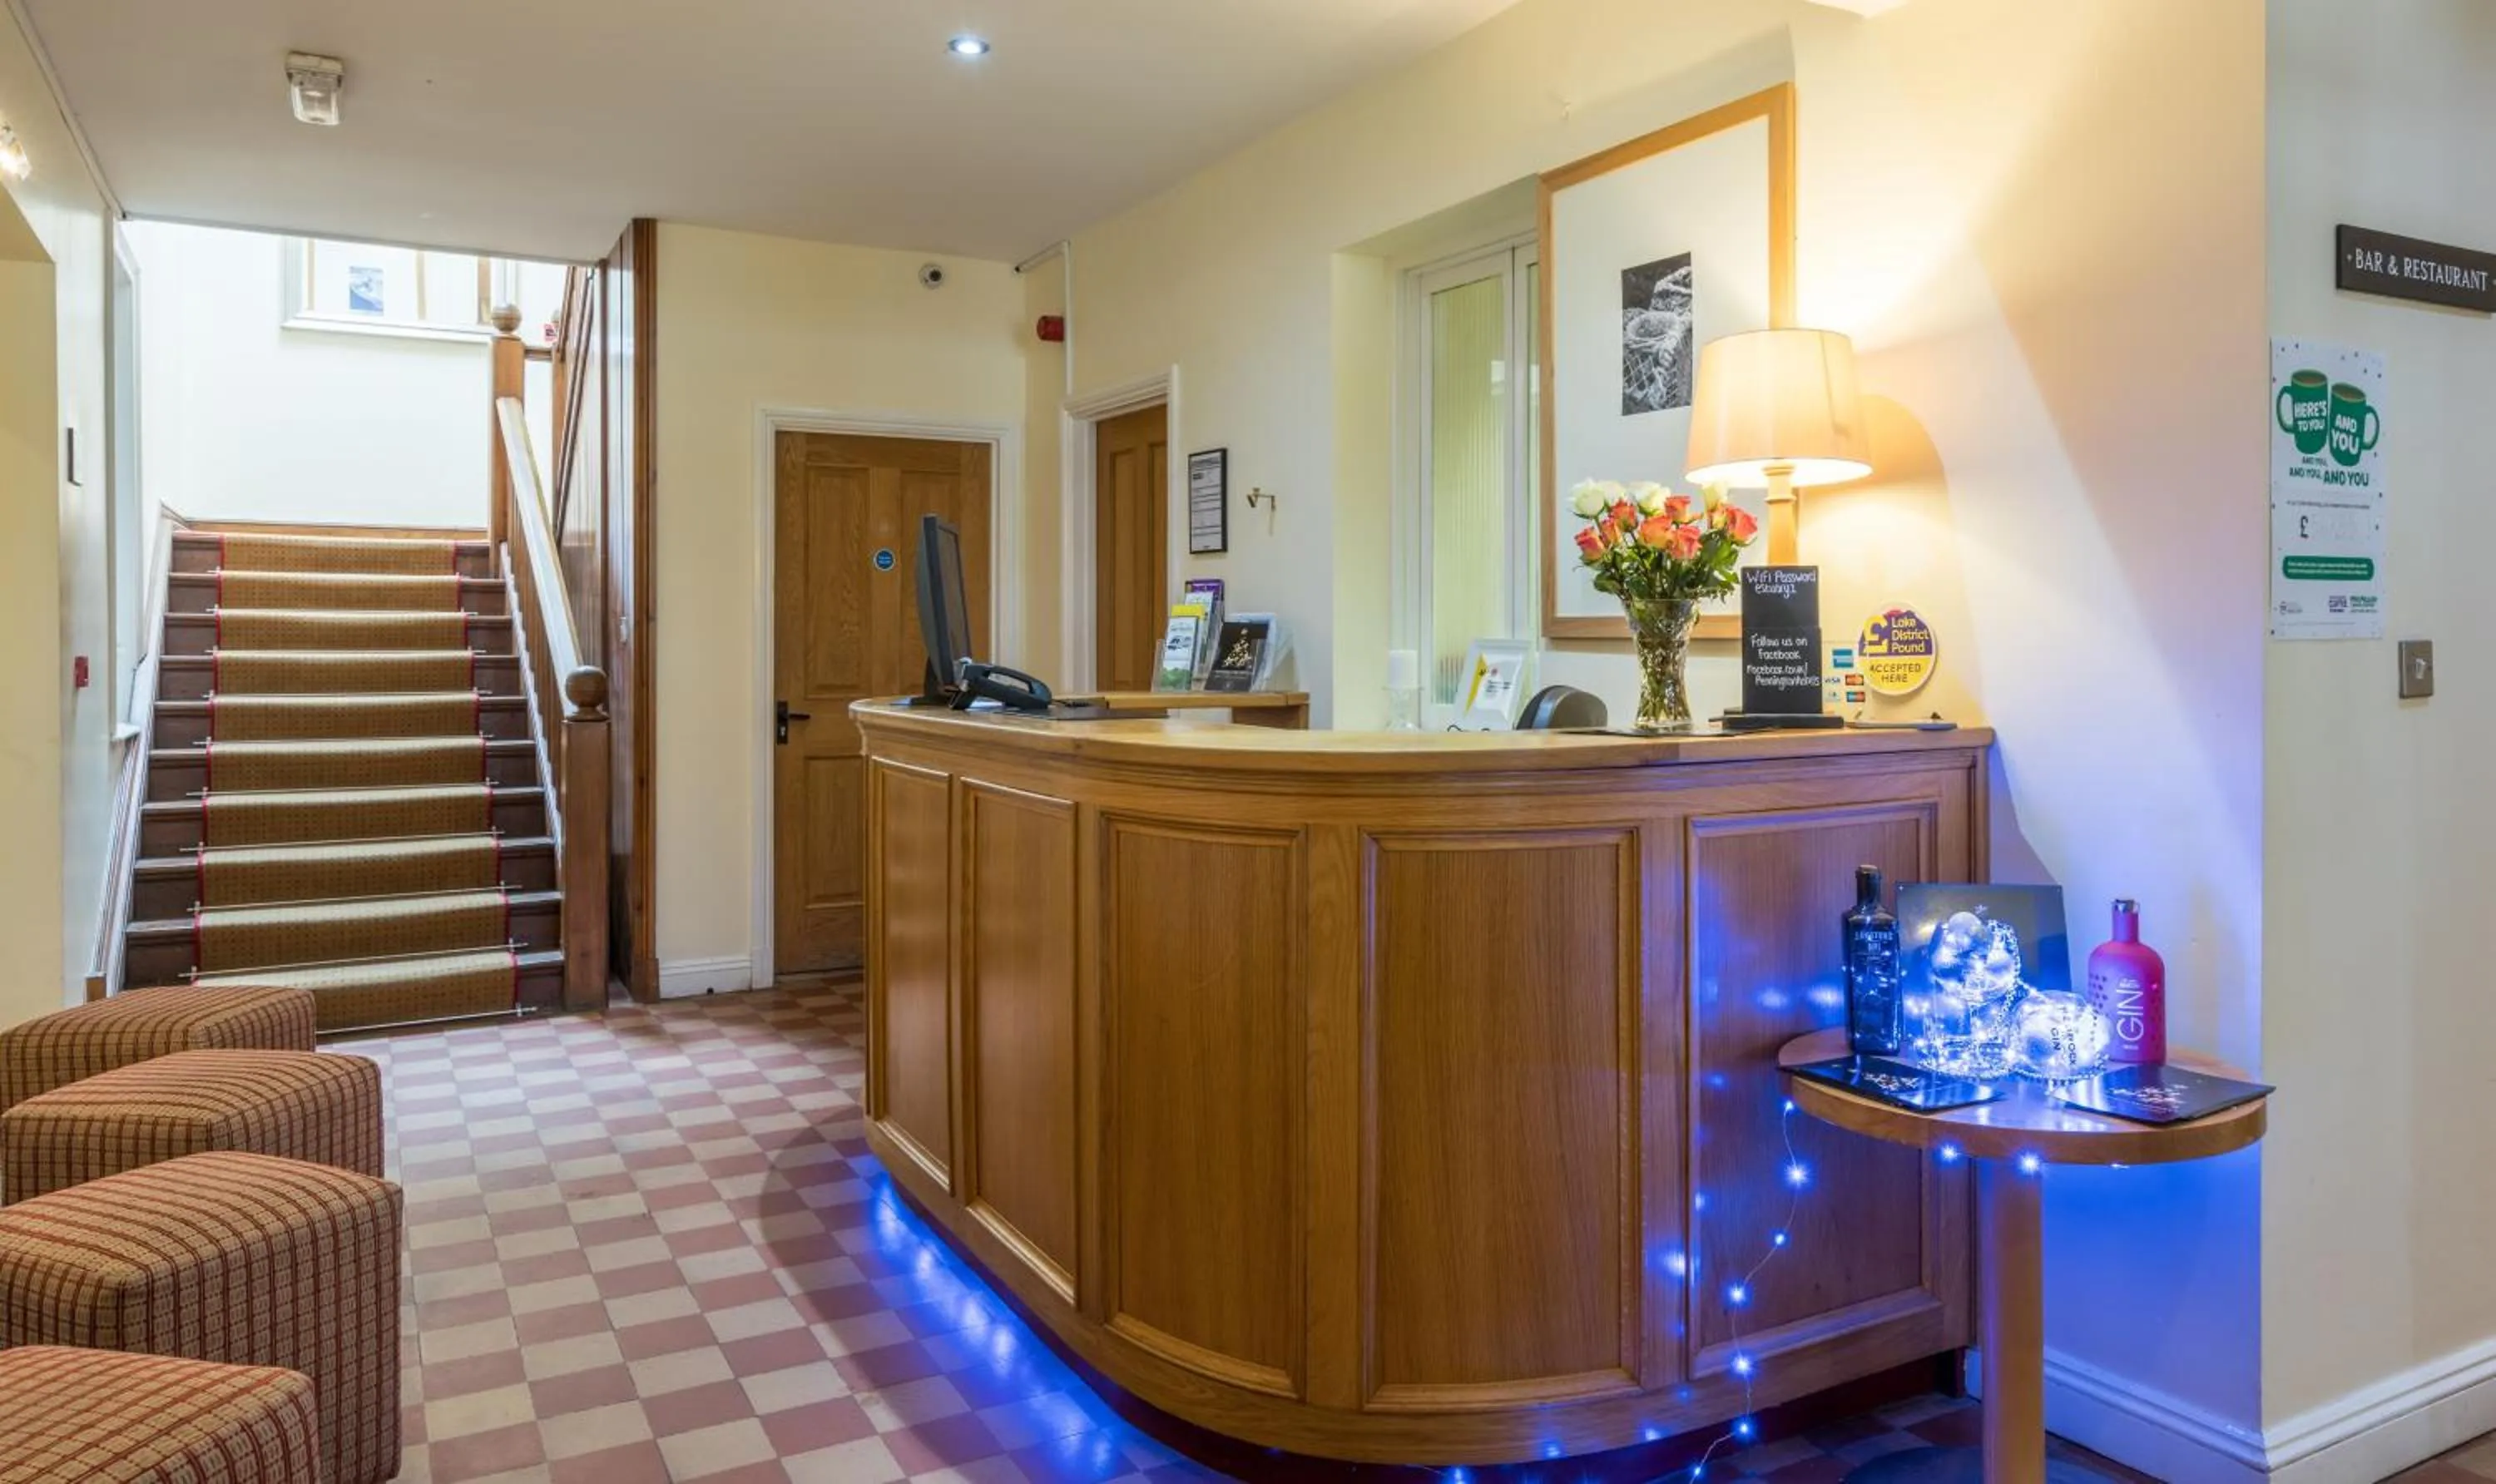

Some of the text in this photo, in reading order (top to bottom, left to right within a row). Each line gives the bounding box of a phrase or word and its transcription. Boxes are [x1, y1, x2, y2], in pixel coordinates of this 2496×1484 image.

[2355, 248, 2489, 291] BAR & RESTAURANT
[2295, 401, 2327, 418] HERE'S
[2297, 418, 2325, 433] TO YOU
[2335, 414, 2357, 433] AND
[2331, 429, 2359, 455] YOU
[2290, 467, 2305, 477] AND
[2324, 470, 2345, 485] AND
[2347, 471, 2370, 487] YOU
[1774, 570, 1817, 583] Password
[1891, 617, 1916, 628] Lake
[1751, 633, 1808, 648] Follow us on
[1891, 629, 1929, 641] District
[1757, 648, 1801, 660] Facebook
[1891, 643, 1925, 653] Pound
[1870, 663, 1921, 673] ACCEPTED
[1881, 674, 1909, 683] HERE
[2116, 988, 2144, 1041] GIN
[2050, 1026, 2062, 1051] GIN
